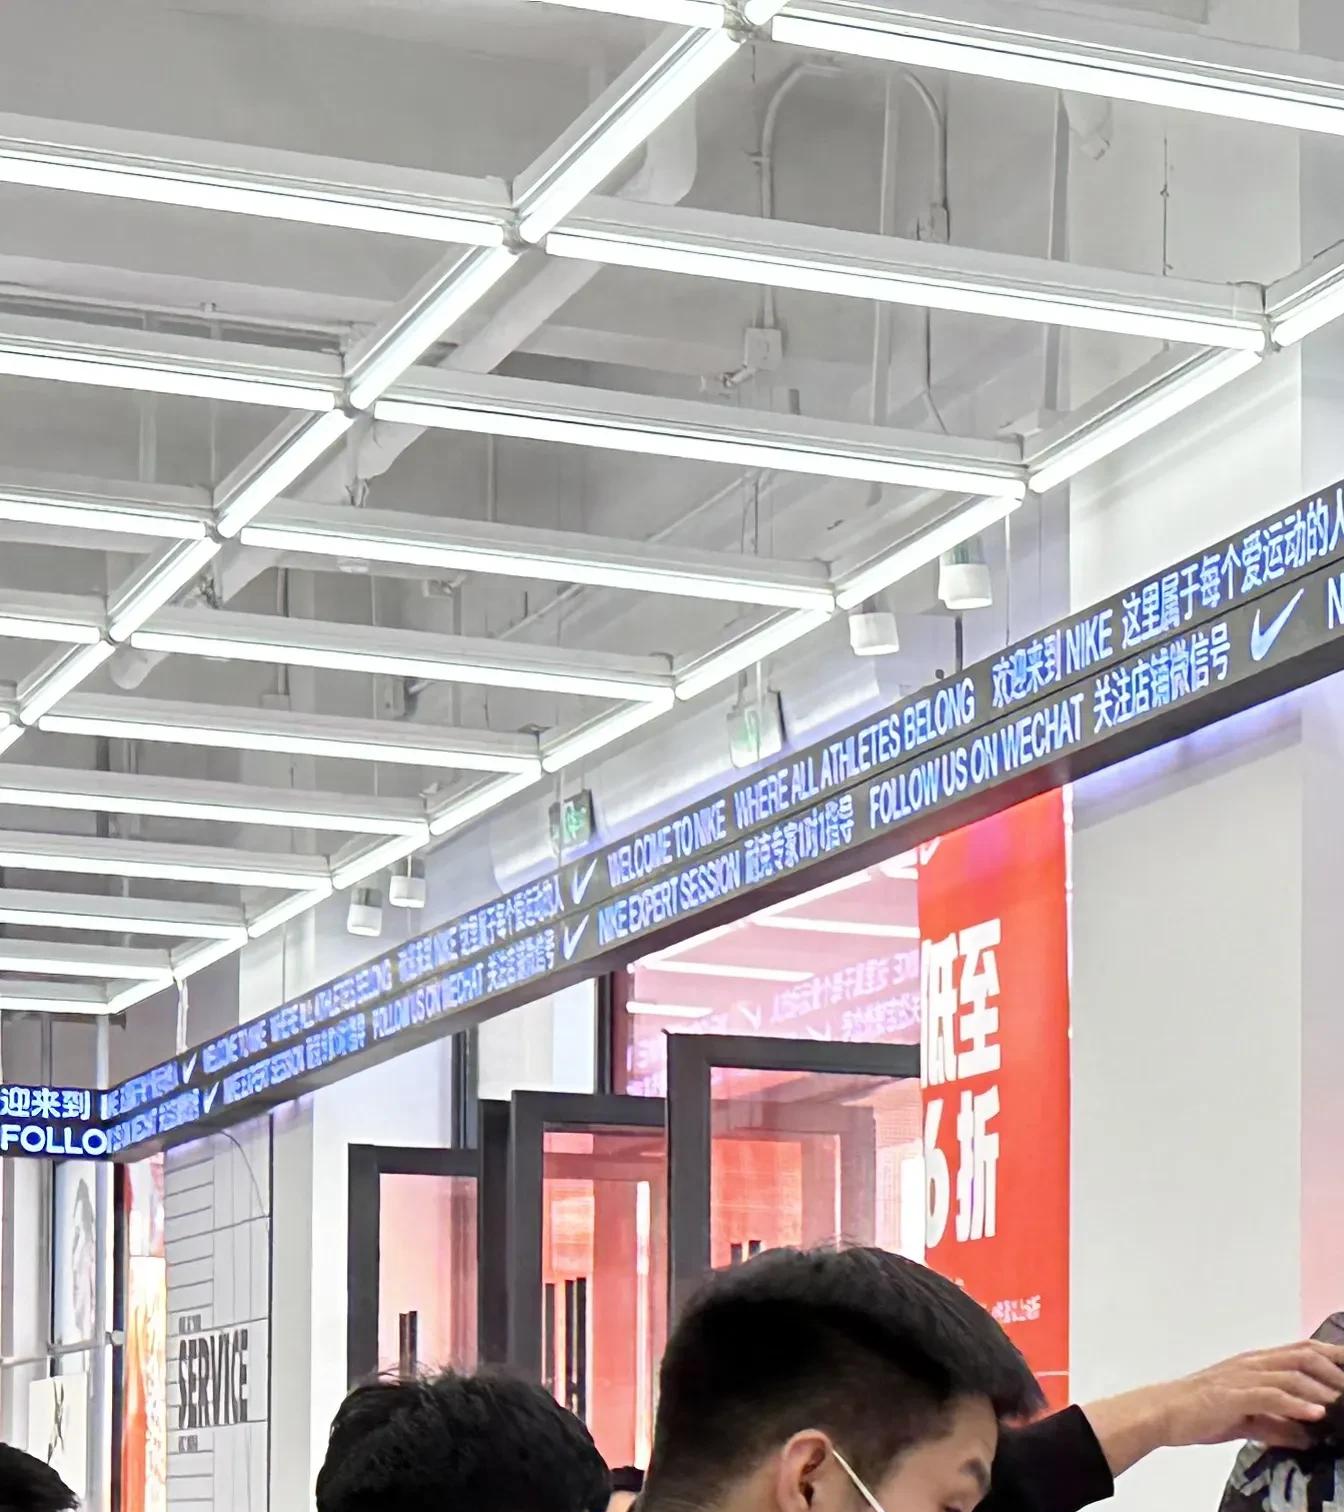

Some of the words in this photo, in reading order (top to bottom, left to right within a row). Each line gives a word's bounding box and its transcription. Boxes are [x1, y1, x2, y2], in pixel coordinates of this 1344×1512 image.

[733, 767, 789, 829] WHERE
[791, 756, 819, 805] ALL
[820, 713, 900, 790] ATHLETES
[903, 677, 975, 751] BELONG
[991, 629, 1062, 709] 欢迎来到
[1065, 608, 1114, 677] NIKE
[869, 757, 940, 829] FOLLOW
[941, 747, 968, 797] US
[971, 733, 998, 784] ON
[1000, 692, 1085, 773] WECHAT
[1093, 622, 1230, 734] 关注店铺微信号
[179, 1328, 248, 1429] SERVICE
